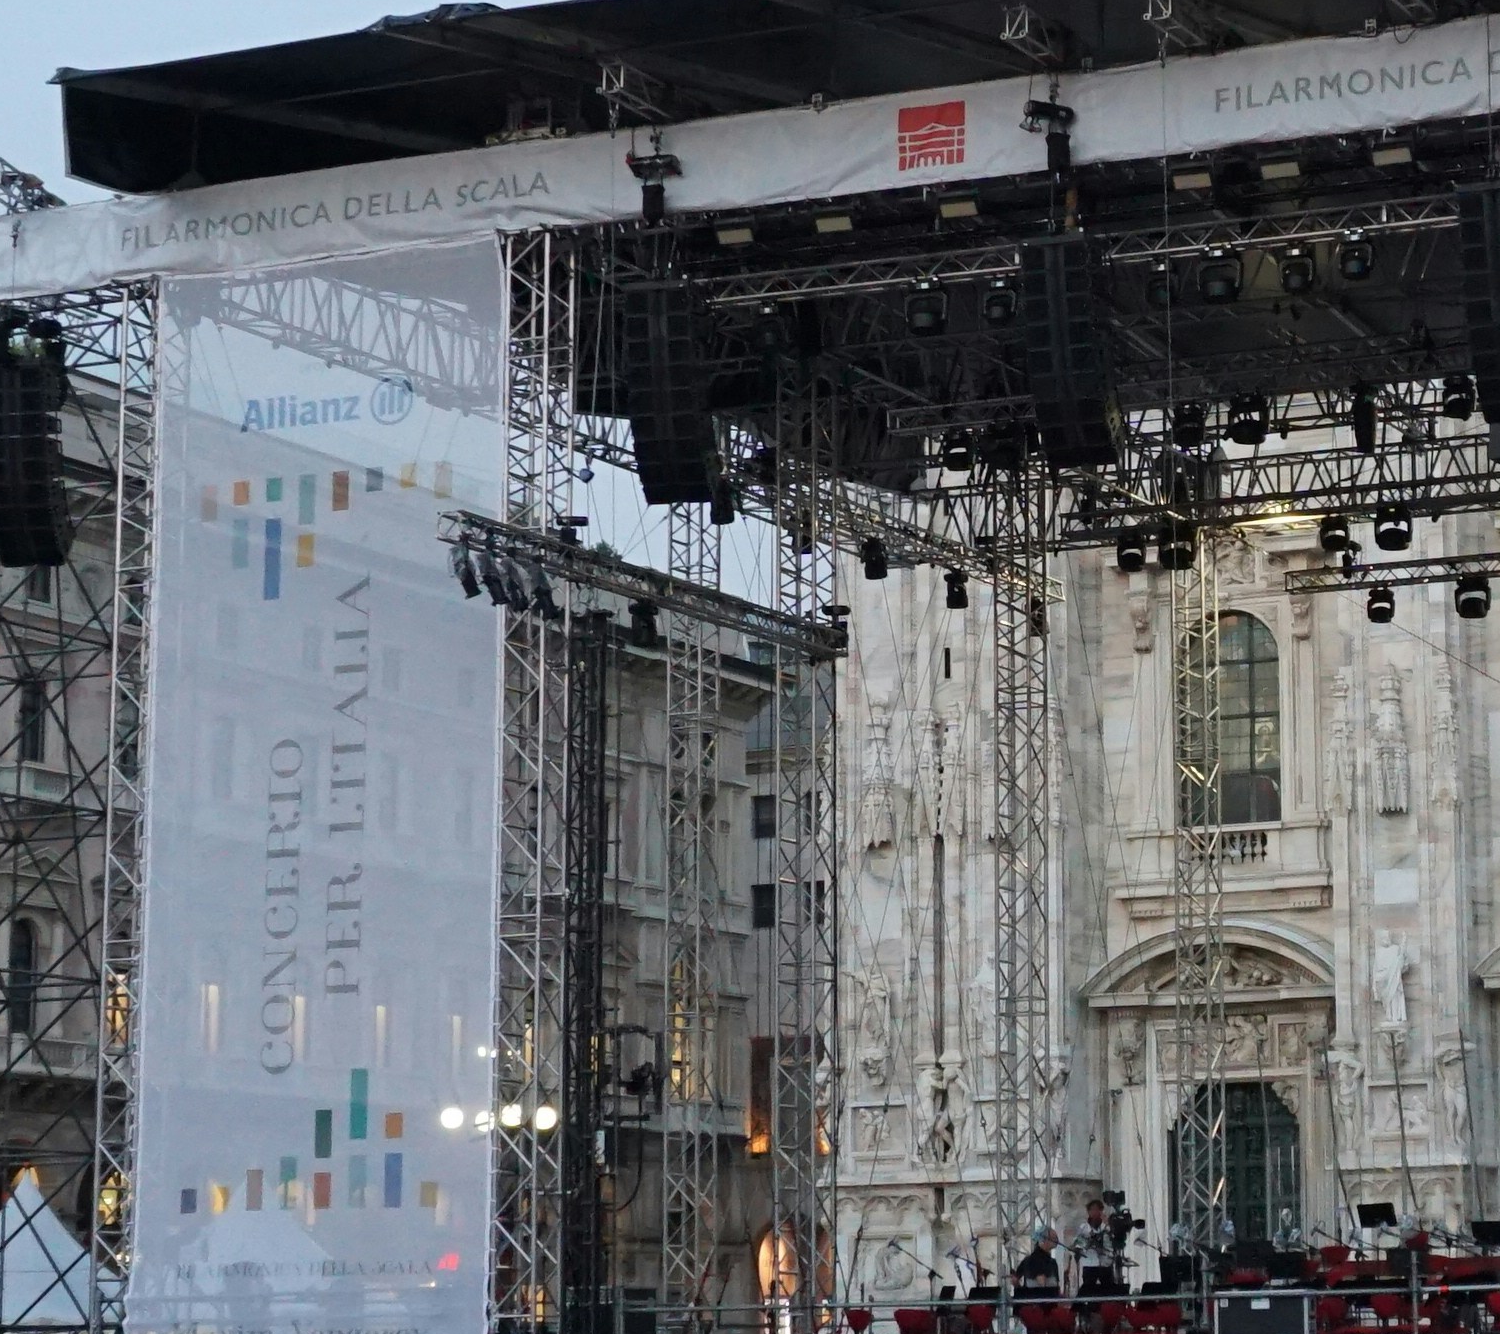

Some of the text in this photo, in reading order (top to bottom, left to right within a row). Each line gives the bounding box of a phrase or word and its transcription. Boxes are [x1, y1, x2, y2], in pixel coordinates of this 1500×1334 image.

[1214, 56, 1473, 114] FILARMONICA
[120, 171, 551, 252] FILARMONICA DELLA SCALA
[242, 392, 361, 432] Allianz
[260, 738, 304, 1076] CONCERTO
[325, 862, 362, 999] PER
